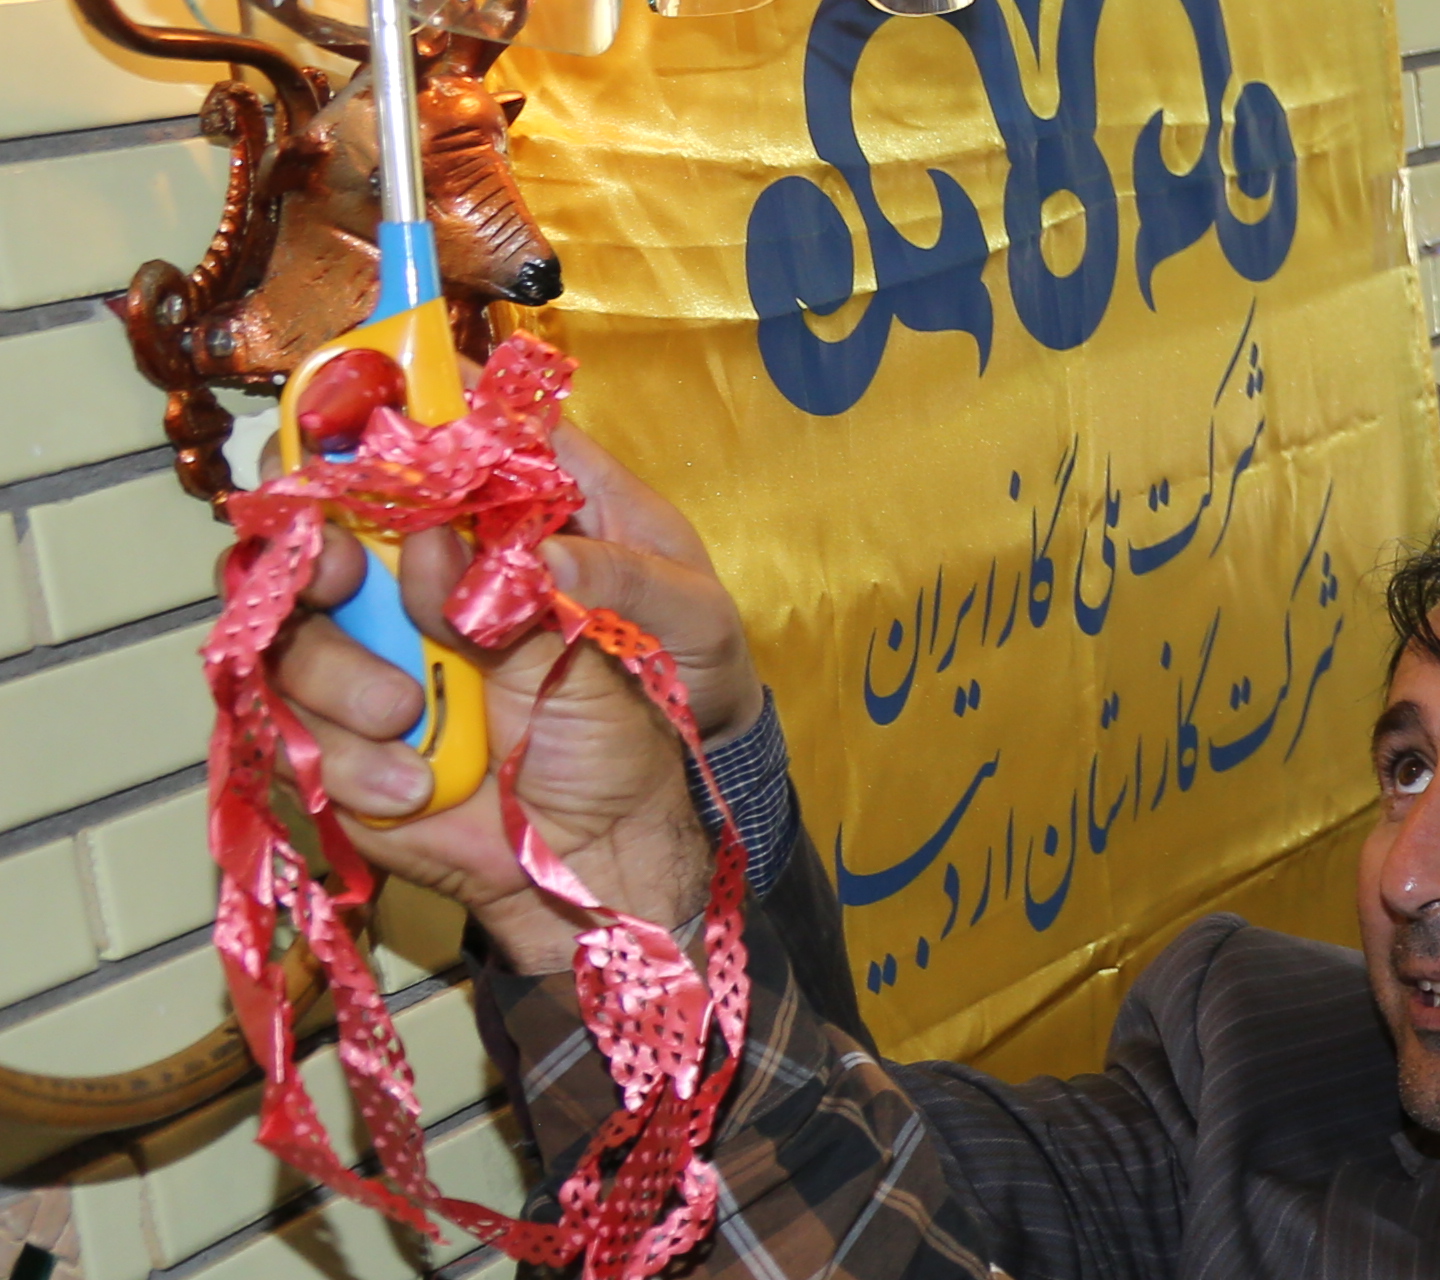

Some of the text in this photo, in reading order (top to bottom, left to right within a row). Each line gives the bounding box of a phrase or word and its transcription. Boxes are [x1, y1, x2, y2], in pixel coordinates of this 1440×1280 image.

[835, 479, 1344, 995] شرکت گاز استان اردبیل
[864, 296, 1265, 725] شرکت ملی گاز ایران
